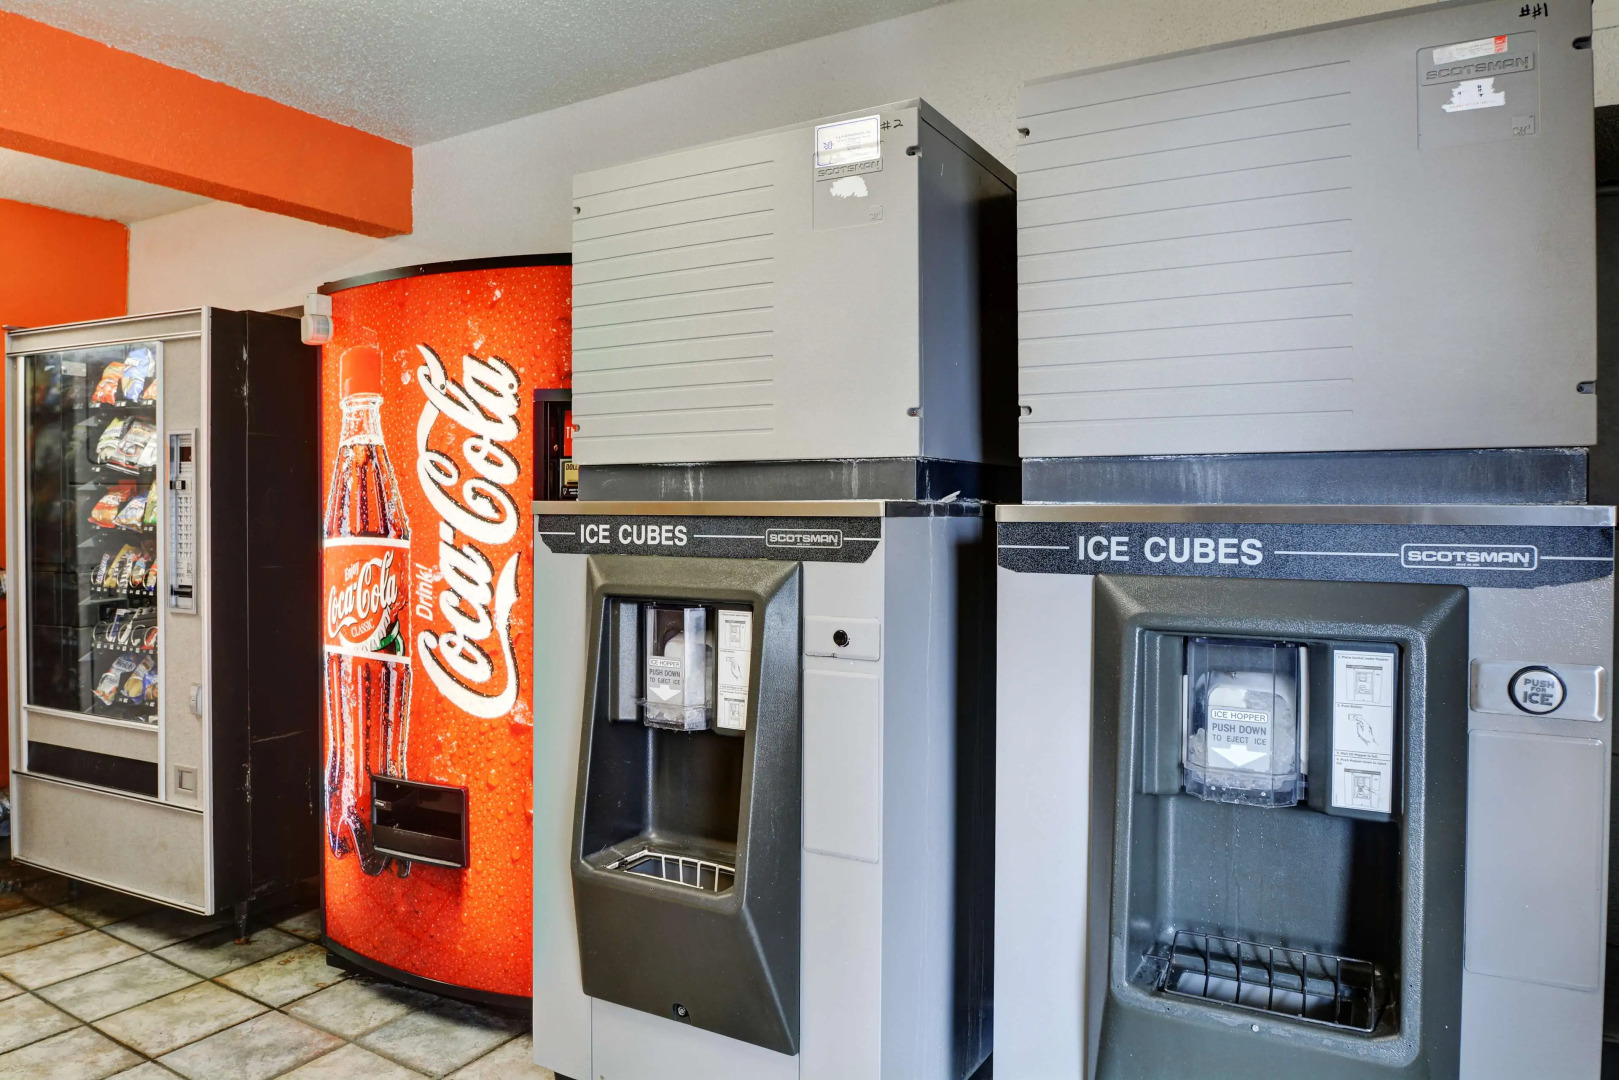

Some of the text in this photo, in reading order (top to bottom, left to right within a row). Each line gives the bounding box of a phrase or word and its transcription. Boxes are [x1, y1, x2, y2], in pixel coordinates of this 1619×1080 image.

[1425, 56, 1529, 80] SCOTSMAN
[880, 119, 904, 131] #2
[818, 160, 880, 177] SCOTSMAN
[416, 343, 523, 719] Coca-Cola
[580, 524, 688, 546] ICE CUBES
[769, 534, 838, 543] SCOTSMAN
[1078, 536, 1263, 565] ICE CUBES
[1408, 551, 1530, 563] SCOTSMAN
[345, 561, 359, 582] Enjoy
[328, 549, 398, 638] Coca-Cola
[415, 562, 433, 621] Drink!
[350, 618, 375, 638] CLASSIC
[1524, 678, 1554, 688] PUSH
[1522, 691, 1553, 706] ICE
[1231, 712, 1266, 722] HOPPER
[1212, 723, 1267, 735] PUSH DOWN
